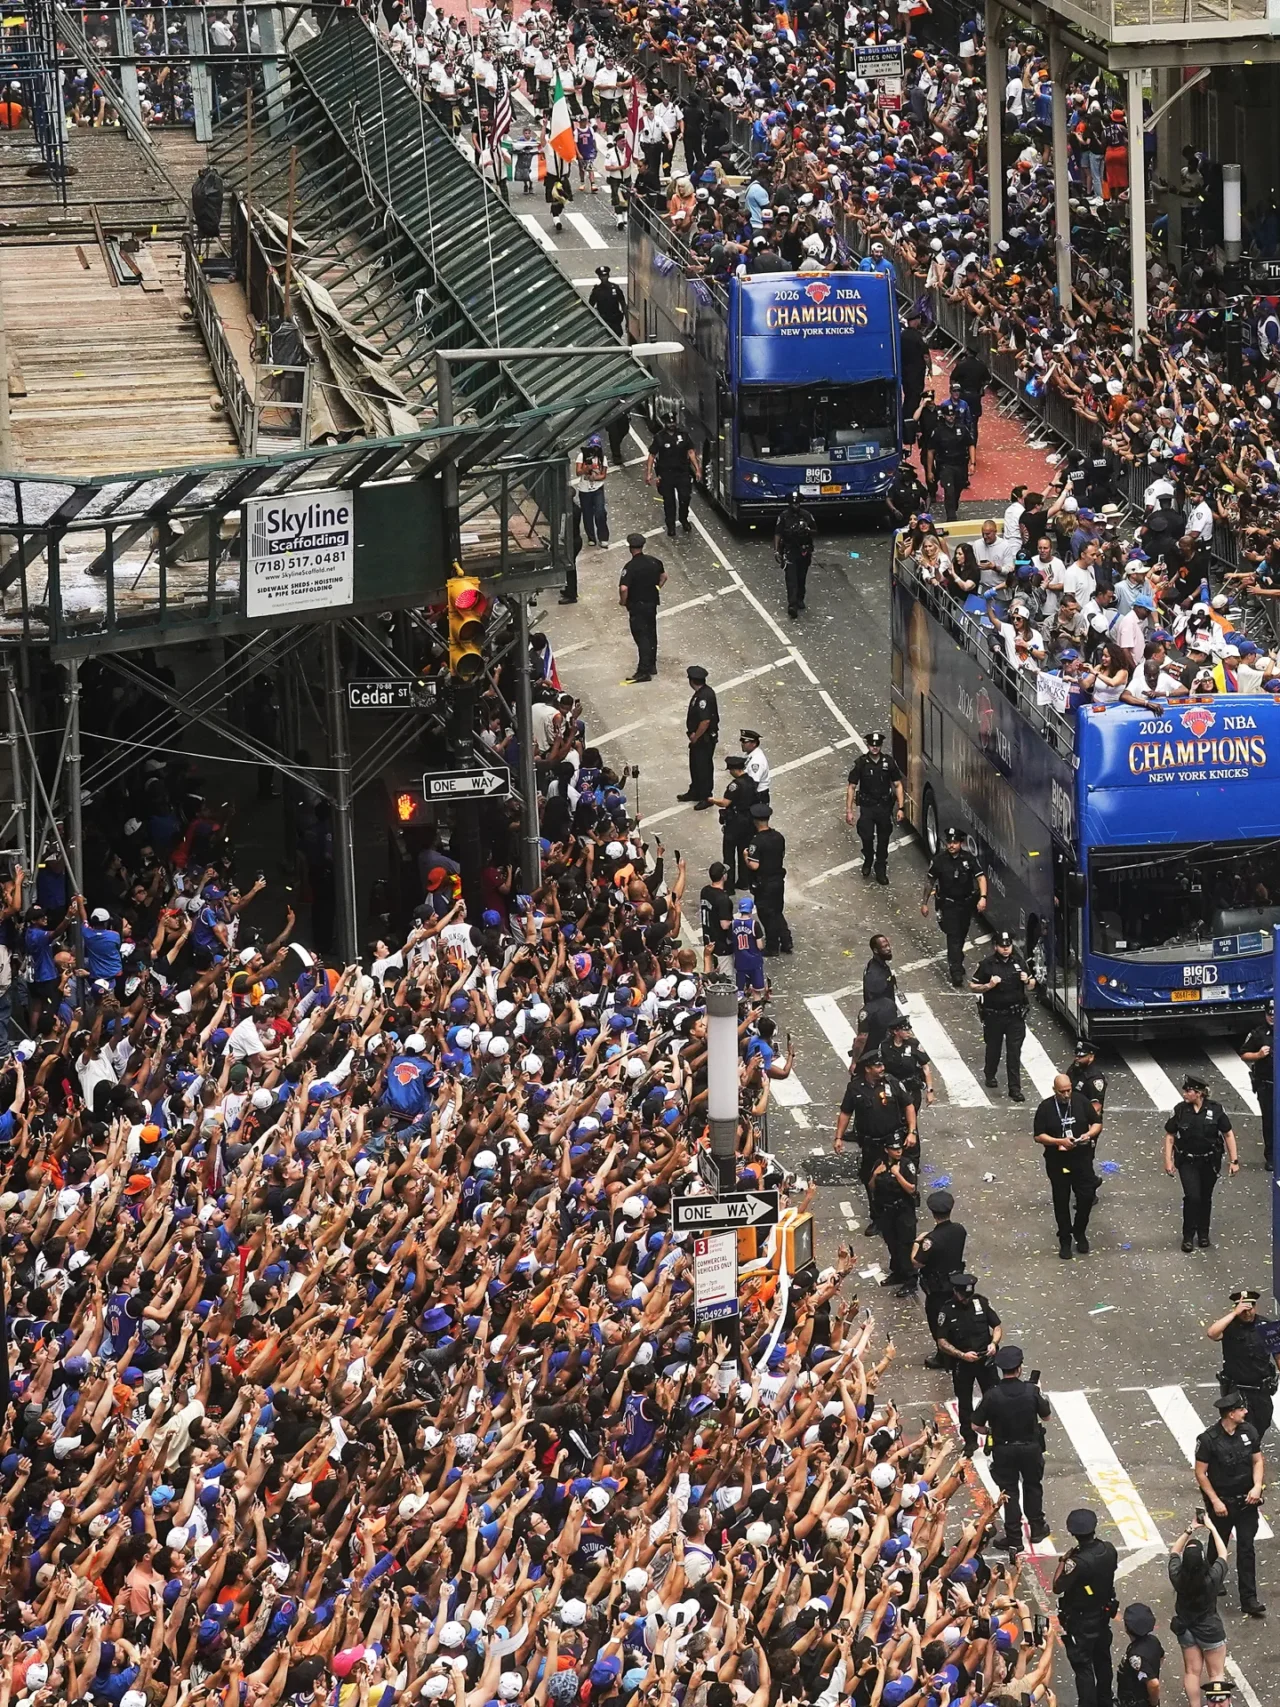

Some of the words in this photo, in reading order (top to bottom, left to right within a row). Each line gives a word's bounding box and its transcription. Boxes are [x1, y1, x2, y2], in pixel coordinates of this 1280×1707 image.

[858, 54, 880, 62] BUSES
[774, 290, 799, 300] 2026
[836, 289, 861, 300] NBA
[766, 304, 868, 329] CHAMPIONS
[781, 328, 800, 336] NEW
[802, 327, 824, 338] YORK
[825, 327, 854, 335] KNICKS
[1092, 458, 1107, 466] NYPD
[806, 468, 820, 476] BIG
[1070, 470, 1085, 479] NYPD
[267, 503, 349, 538] Skyline
[271, 534, 345, 552] Scaffolding
[254, 559, 286, 575] (718)
[288, 551, 346, 569] 517.0481
[257, 584, 289, 594] SIDEWALK
[291, 581, 310, 590] SHEDS
[314, 576, 344, 586] HOISTING
[275, 590, 289, 598] PIPE
[290, 584, 333, 596] SCAFFOLDING
[351, 689, 394, 704] Cedar
[398, 688, 408, 697] ST
[958, 685, 974, 723] 2026
[1139, 720, 1173, 735] 2026
[1223, 715, 1257, 730] NBA
[996, 727, 1012, 770] NBA
[1128, 735, 1267, 775] CHAMPIONS
[1148, 772, 1175, 783] NEW
[1178, 770, 1207, 781] YORK
[1209, 768, 1249, 780] KNICKS
[433, 780, 456, 792] ONE
[471, 777, 495, 788] WAY
[1051, 778, 1063, 812] BIG
[737, 934, 749, 950] 11
[1183, 966, 1202, 976] BIG
[1183, 976, 1202, 986] BUS
[684, 1206, 712, 1220] ONE
[727, 1202, 758, 1217] WAY
[698, 1240, 706, 1255] 3
[697, 1255, 728, 1268] COMMERCIAL
[697, 1265, 720, 1275] VEHICLES
[720, 1261, 732, 1270] ONLY
